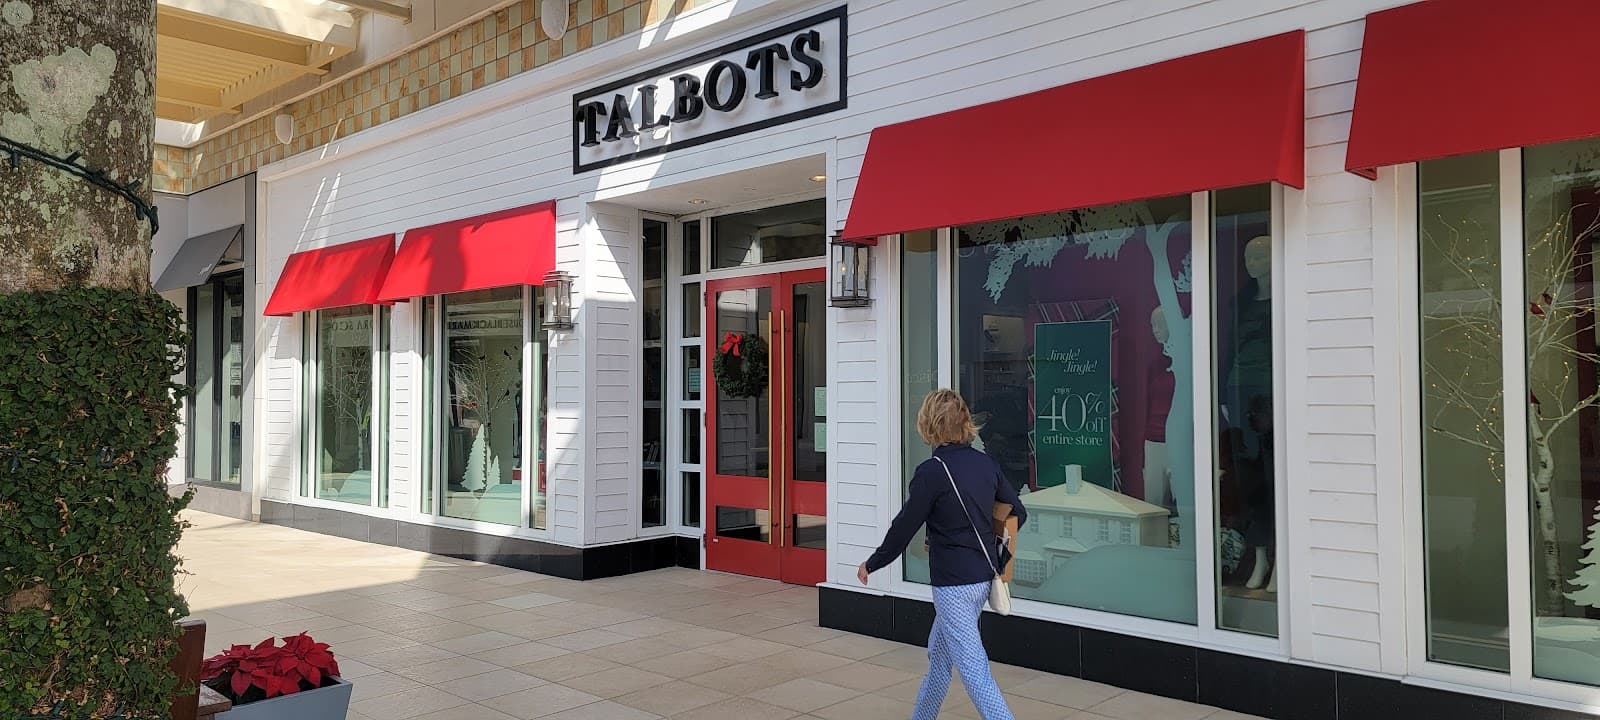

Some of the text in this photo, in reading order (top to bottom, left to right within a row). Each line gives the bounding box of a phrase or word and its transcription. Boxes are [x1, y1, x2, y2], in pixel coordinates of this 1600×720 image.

[575, 29, 824, 148] TALBOTS
[1046, 348, 1081, 363] Jingle!
[1063, 360, 1098, 375] Jingle!
[1037, 392, 1107, 433] 40% off
[1042, 433, 1103, 446] entire store
